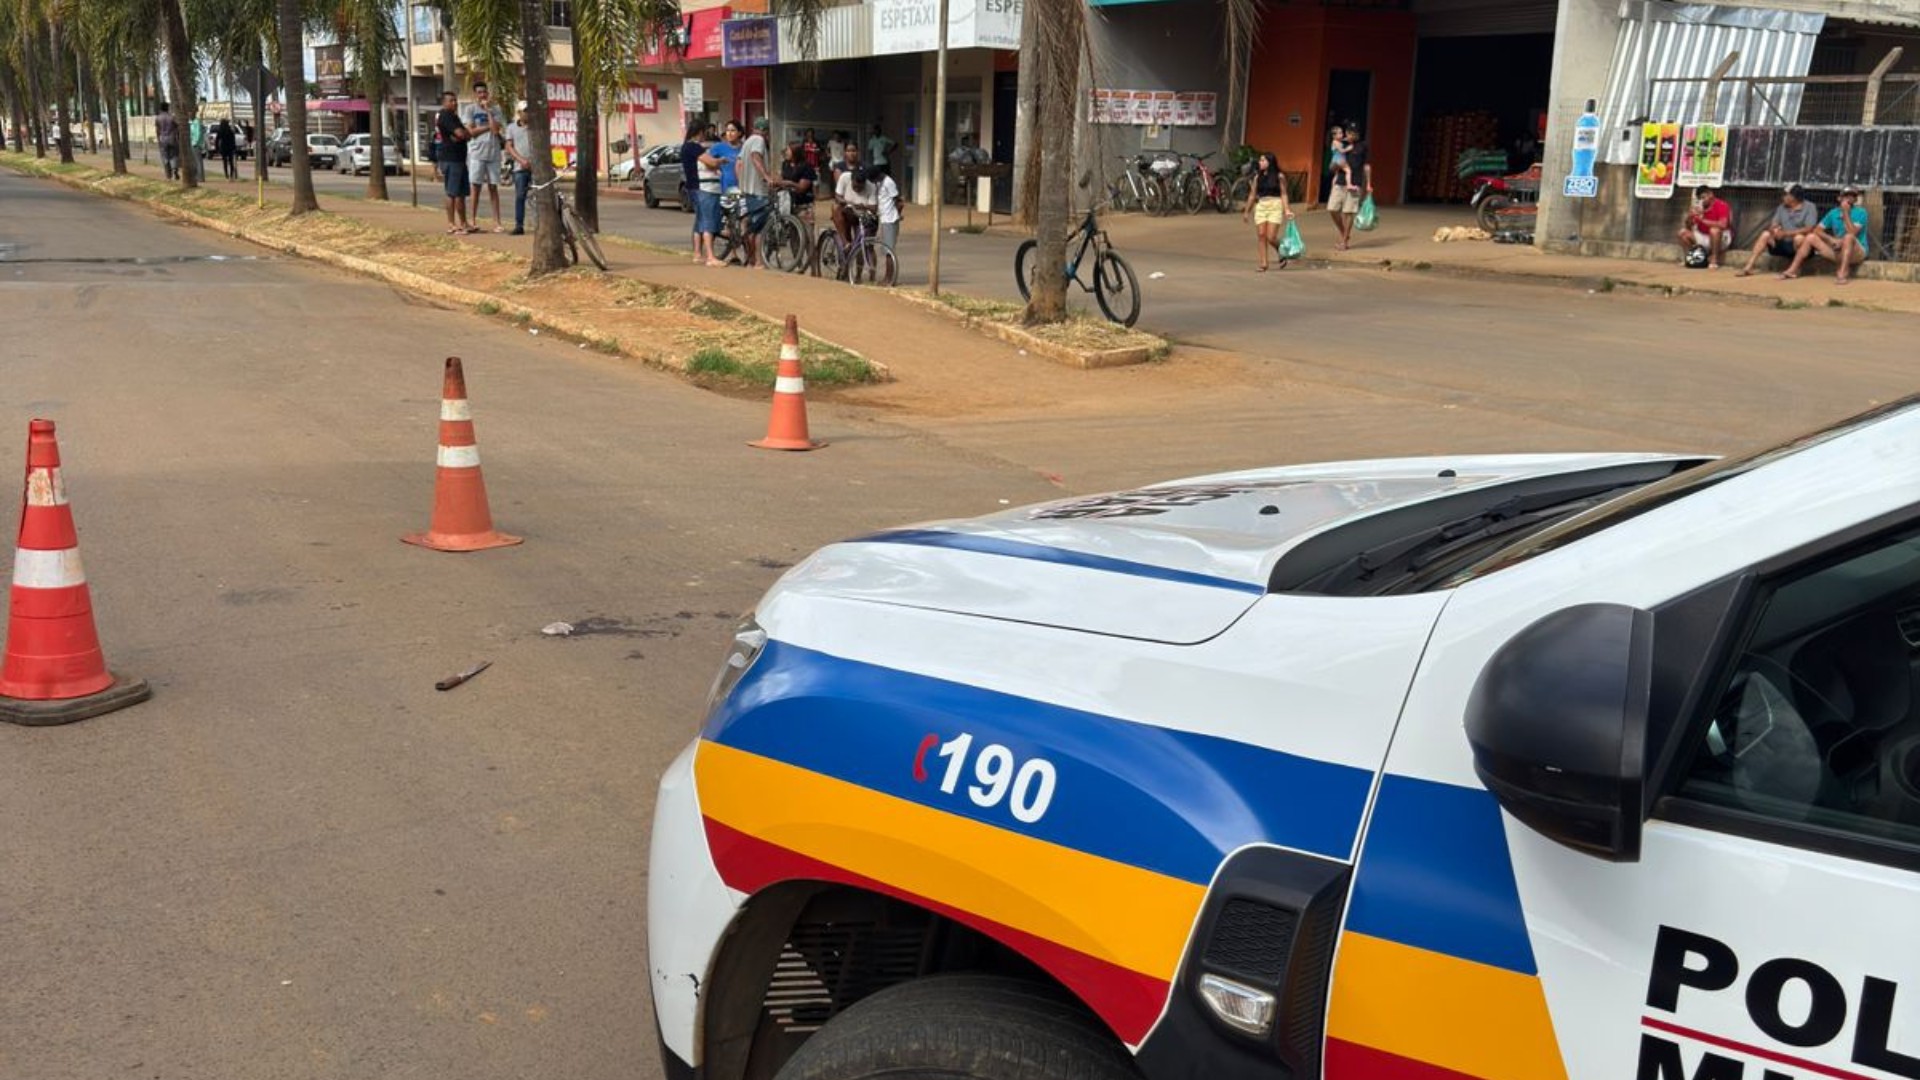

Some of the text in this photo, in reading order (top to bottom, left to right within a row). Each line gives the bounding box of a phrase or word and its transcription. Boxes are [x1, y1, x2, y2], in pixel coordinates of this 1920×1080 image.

[881, 4, 935, 29] ESPETAXI
[1567, 179, 1593, 189] ZERO
[938, 732, 1057, 823] 190
